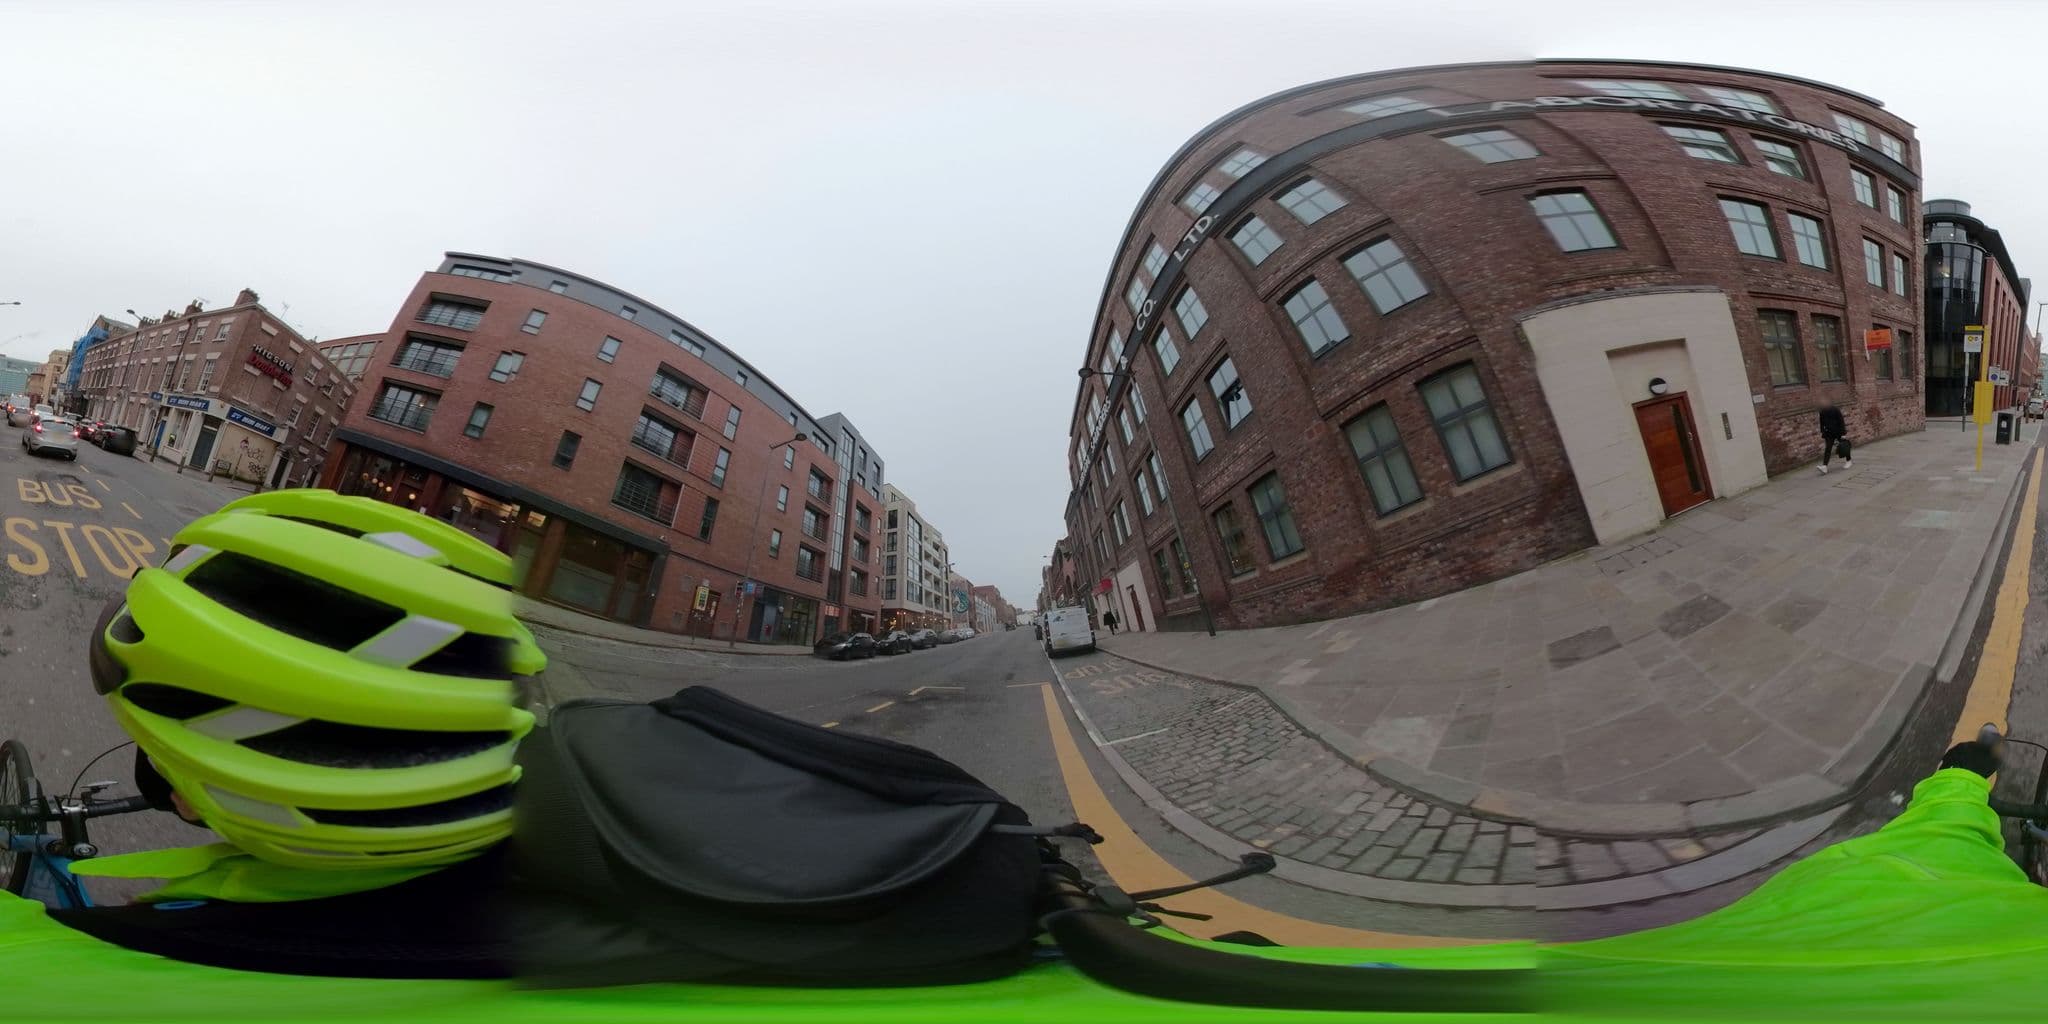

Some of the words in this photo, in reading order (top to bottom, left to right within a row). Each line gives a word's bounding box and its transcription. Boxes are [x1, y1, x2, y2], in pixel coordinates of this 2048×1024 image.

[1428, 96, 1861, 153] LABORATORIES
[1136, 298, 1158, 331] CO.
[1173, 214, 1220, 263] LTD.
[17, 478, 102, 510] BUS
[4, 517, 156, 580] STOP
